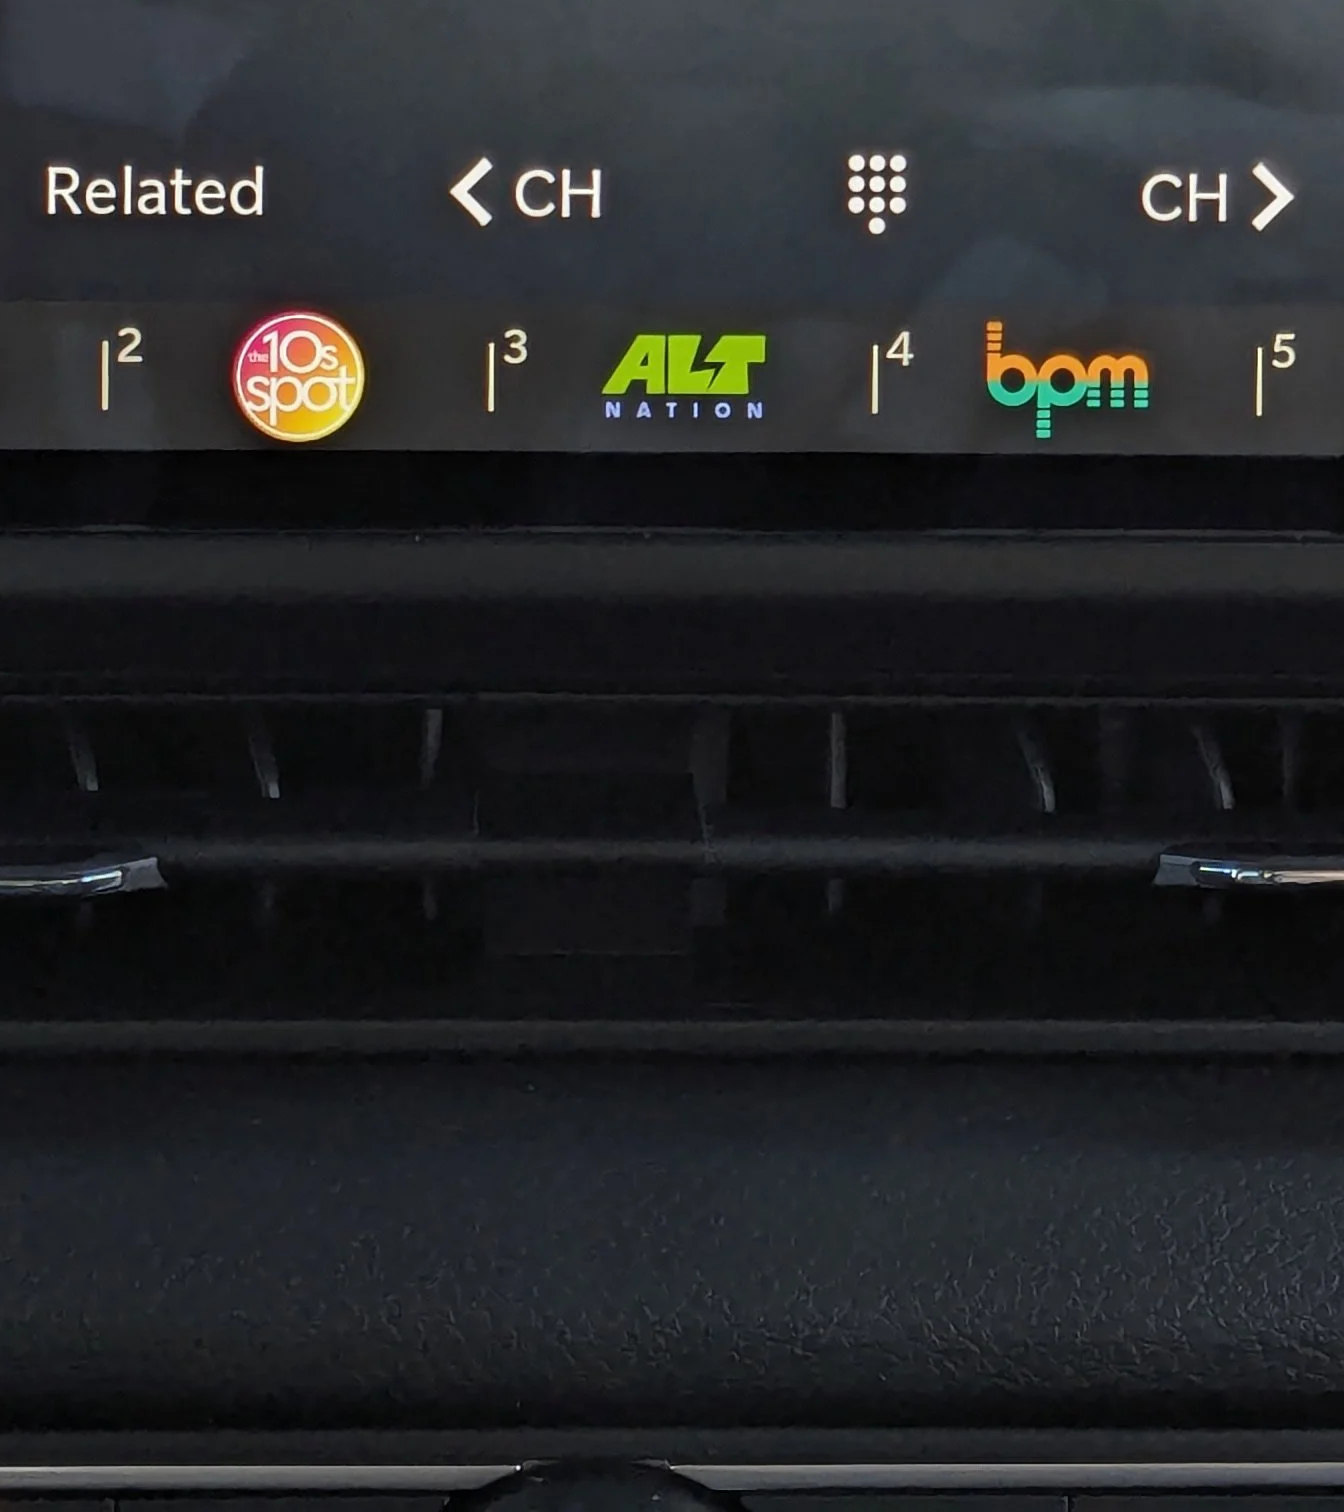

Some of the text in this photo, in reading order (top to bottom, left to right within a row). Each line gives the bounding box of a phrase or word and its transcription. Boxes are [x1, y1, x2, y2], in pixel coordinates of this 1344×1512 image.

[45, 164, 265, 217] Related
[513, 168, 603, 220] CH
[1140, 172, 1230, 224] CH
[116, 328, 144, 363] 2
[248, 330, 339, 374] the 10s
[503, 329, 529, 365] 3
[602, 333, 767, 396] ALT
[885, 331, 915, 366] 4
[1271, 334, 1297, 368] 5
[246, 365, 357, 427] spot
[985, 320, 1150, 440] bpm
[604, 401, 764, 419] NATION
